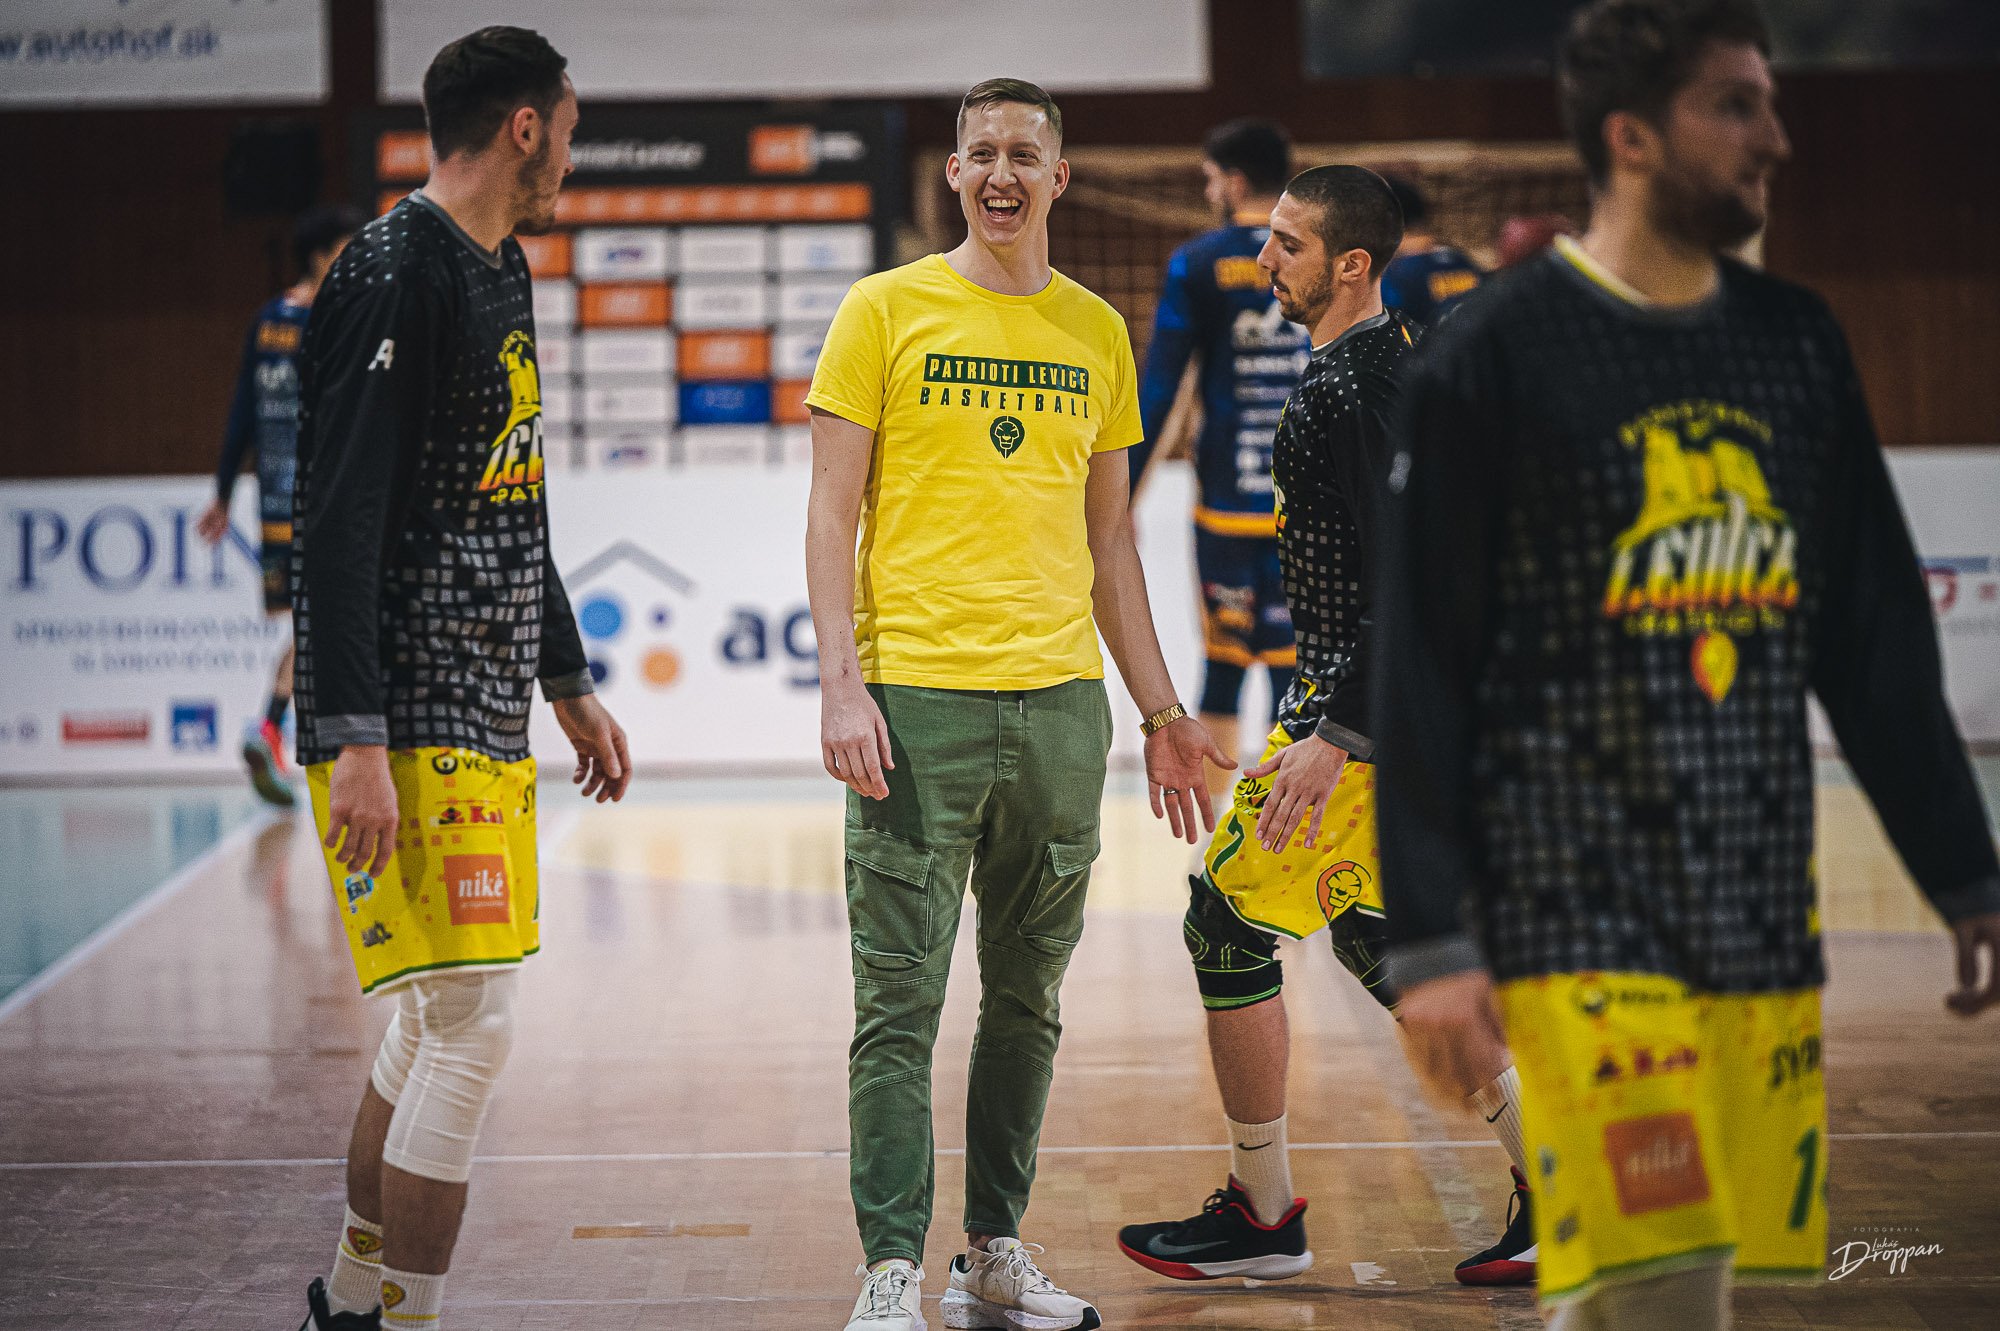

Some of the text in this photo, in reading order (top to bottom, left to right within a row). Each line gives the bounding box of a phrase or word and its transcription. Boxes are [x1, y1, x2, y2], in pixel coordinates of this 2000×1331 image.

[929, 358, 1088, 391] PATRIOTI LEVICE
[919, 386, 1089, 419] BASKETBALL
